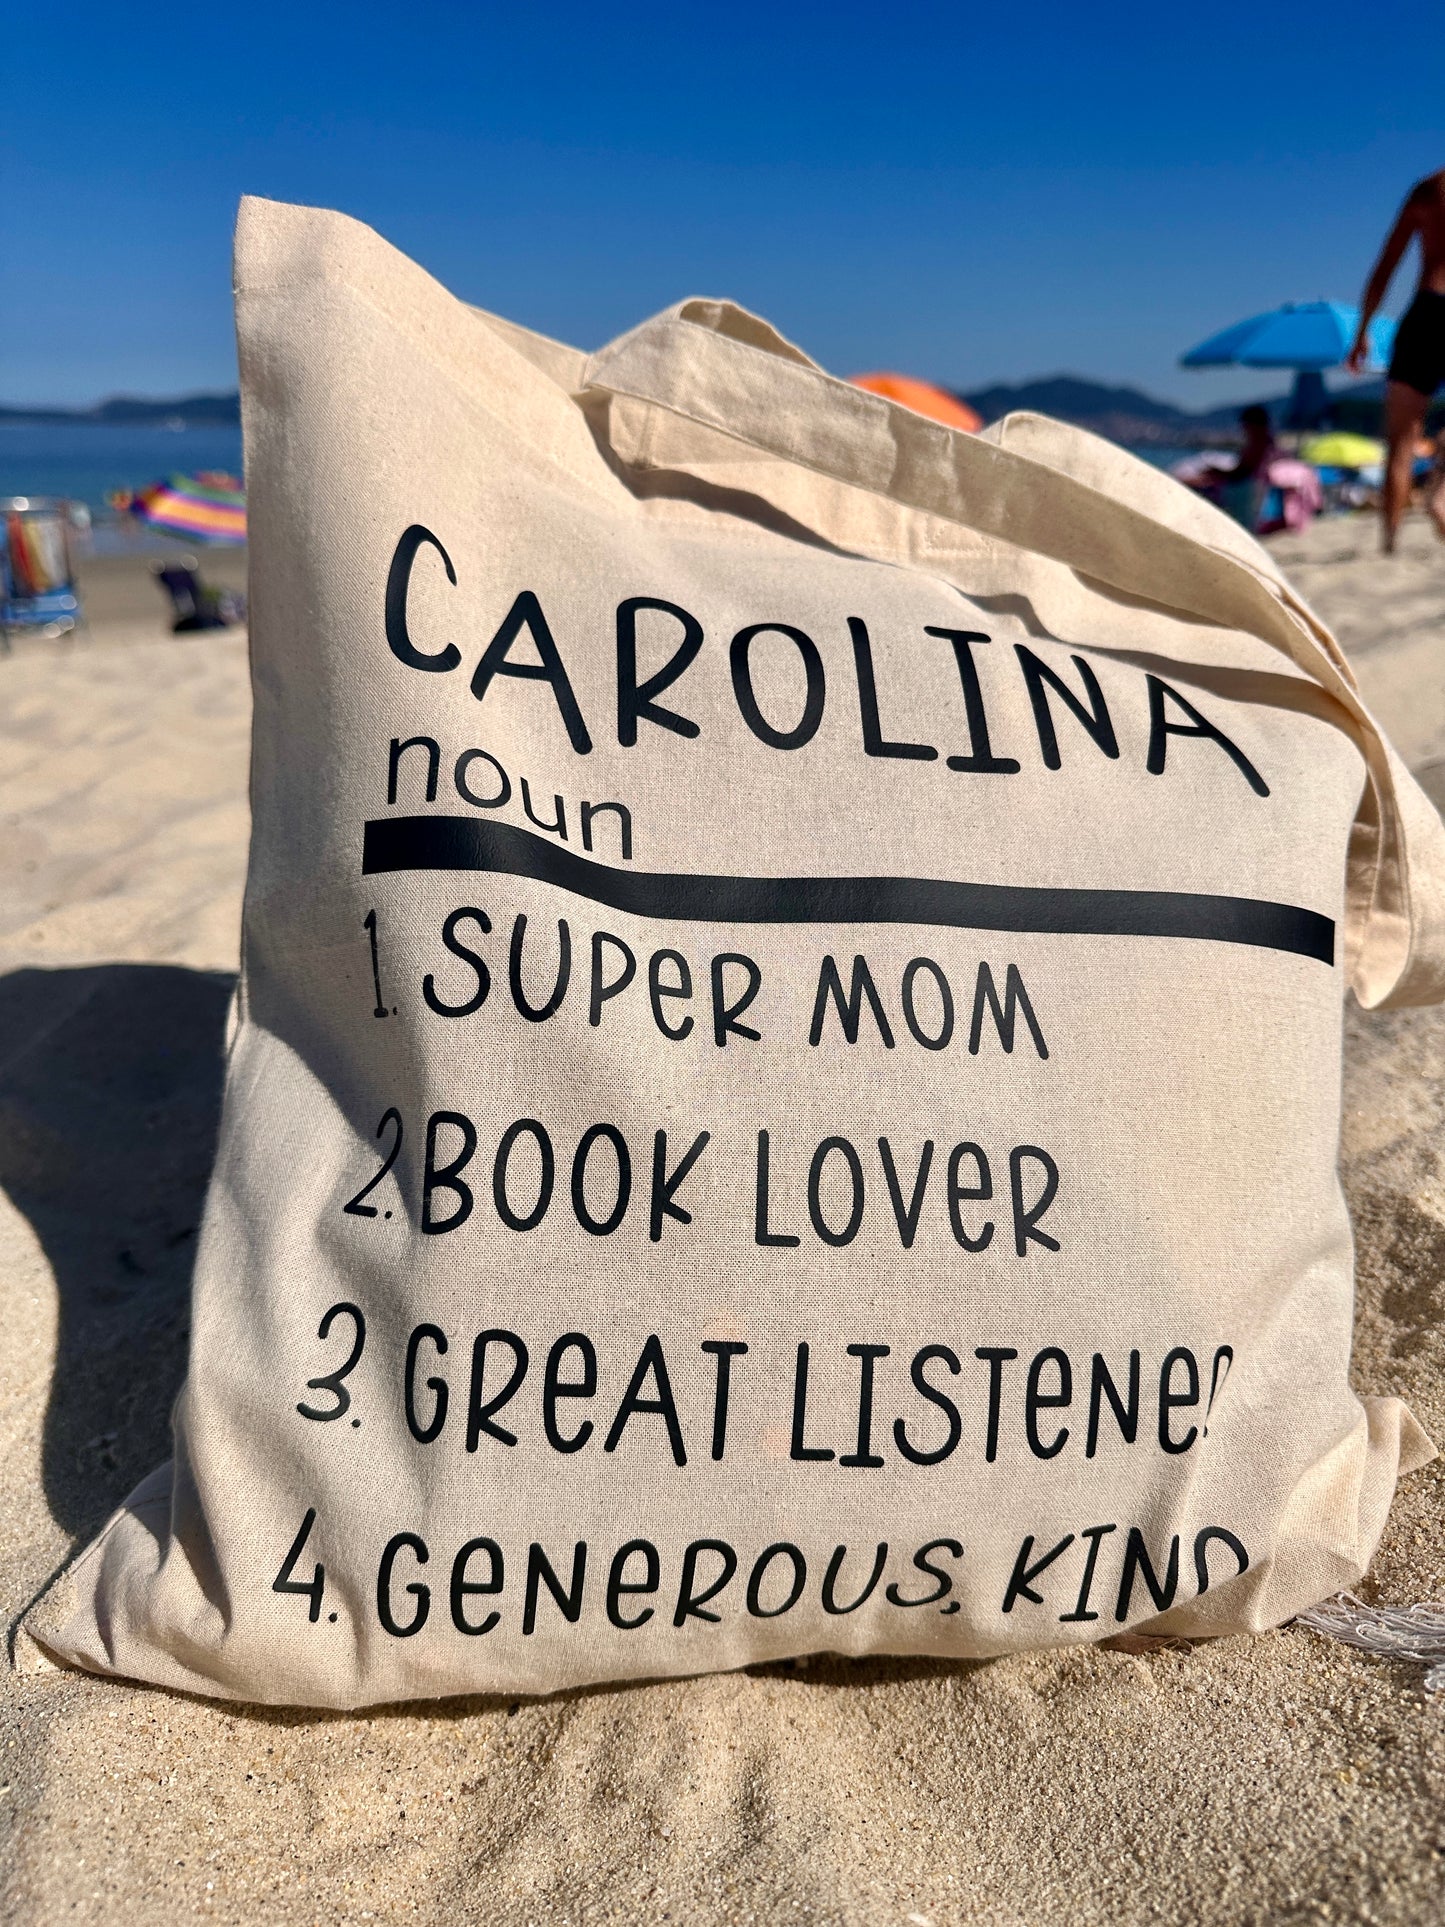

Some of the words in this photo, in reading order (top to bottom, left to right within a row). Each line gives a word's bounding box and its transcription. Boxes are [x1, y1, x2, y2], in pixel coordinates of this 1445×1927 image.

[385, 524, 1271, 798] CAROLINA
[387, 736, 633, 860] noun
[363, 908, 399, 1019] 1.
[808, 954, 1050, 1060] MOM
[343, 1106, 404, 1220] 2.
[421, 1110, 711, 1243] BOOK
[296, 1301, 367, 1429] 3.
[271, 1507, 339, 1624] 4.
